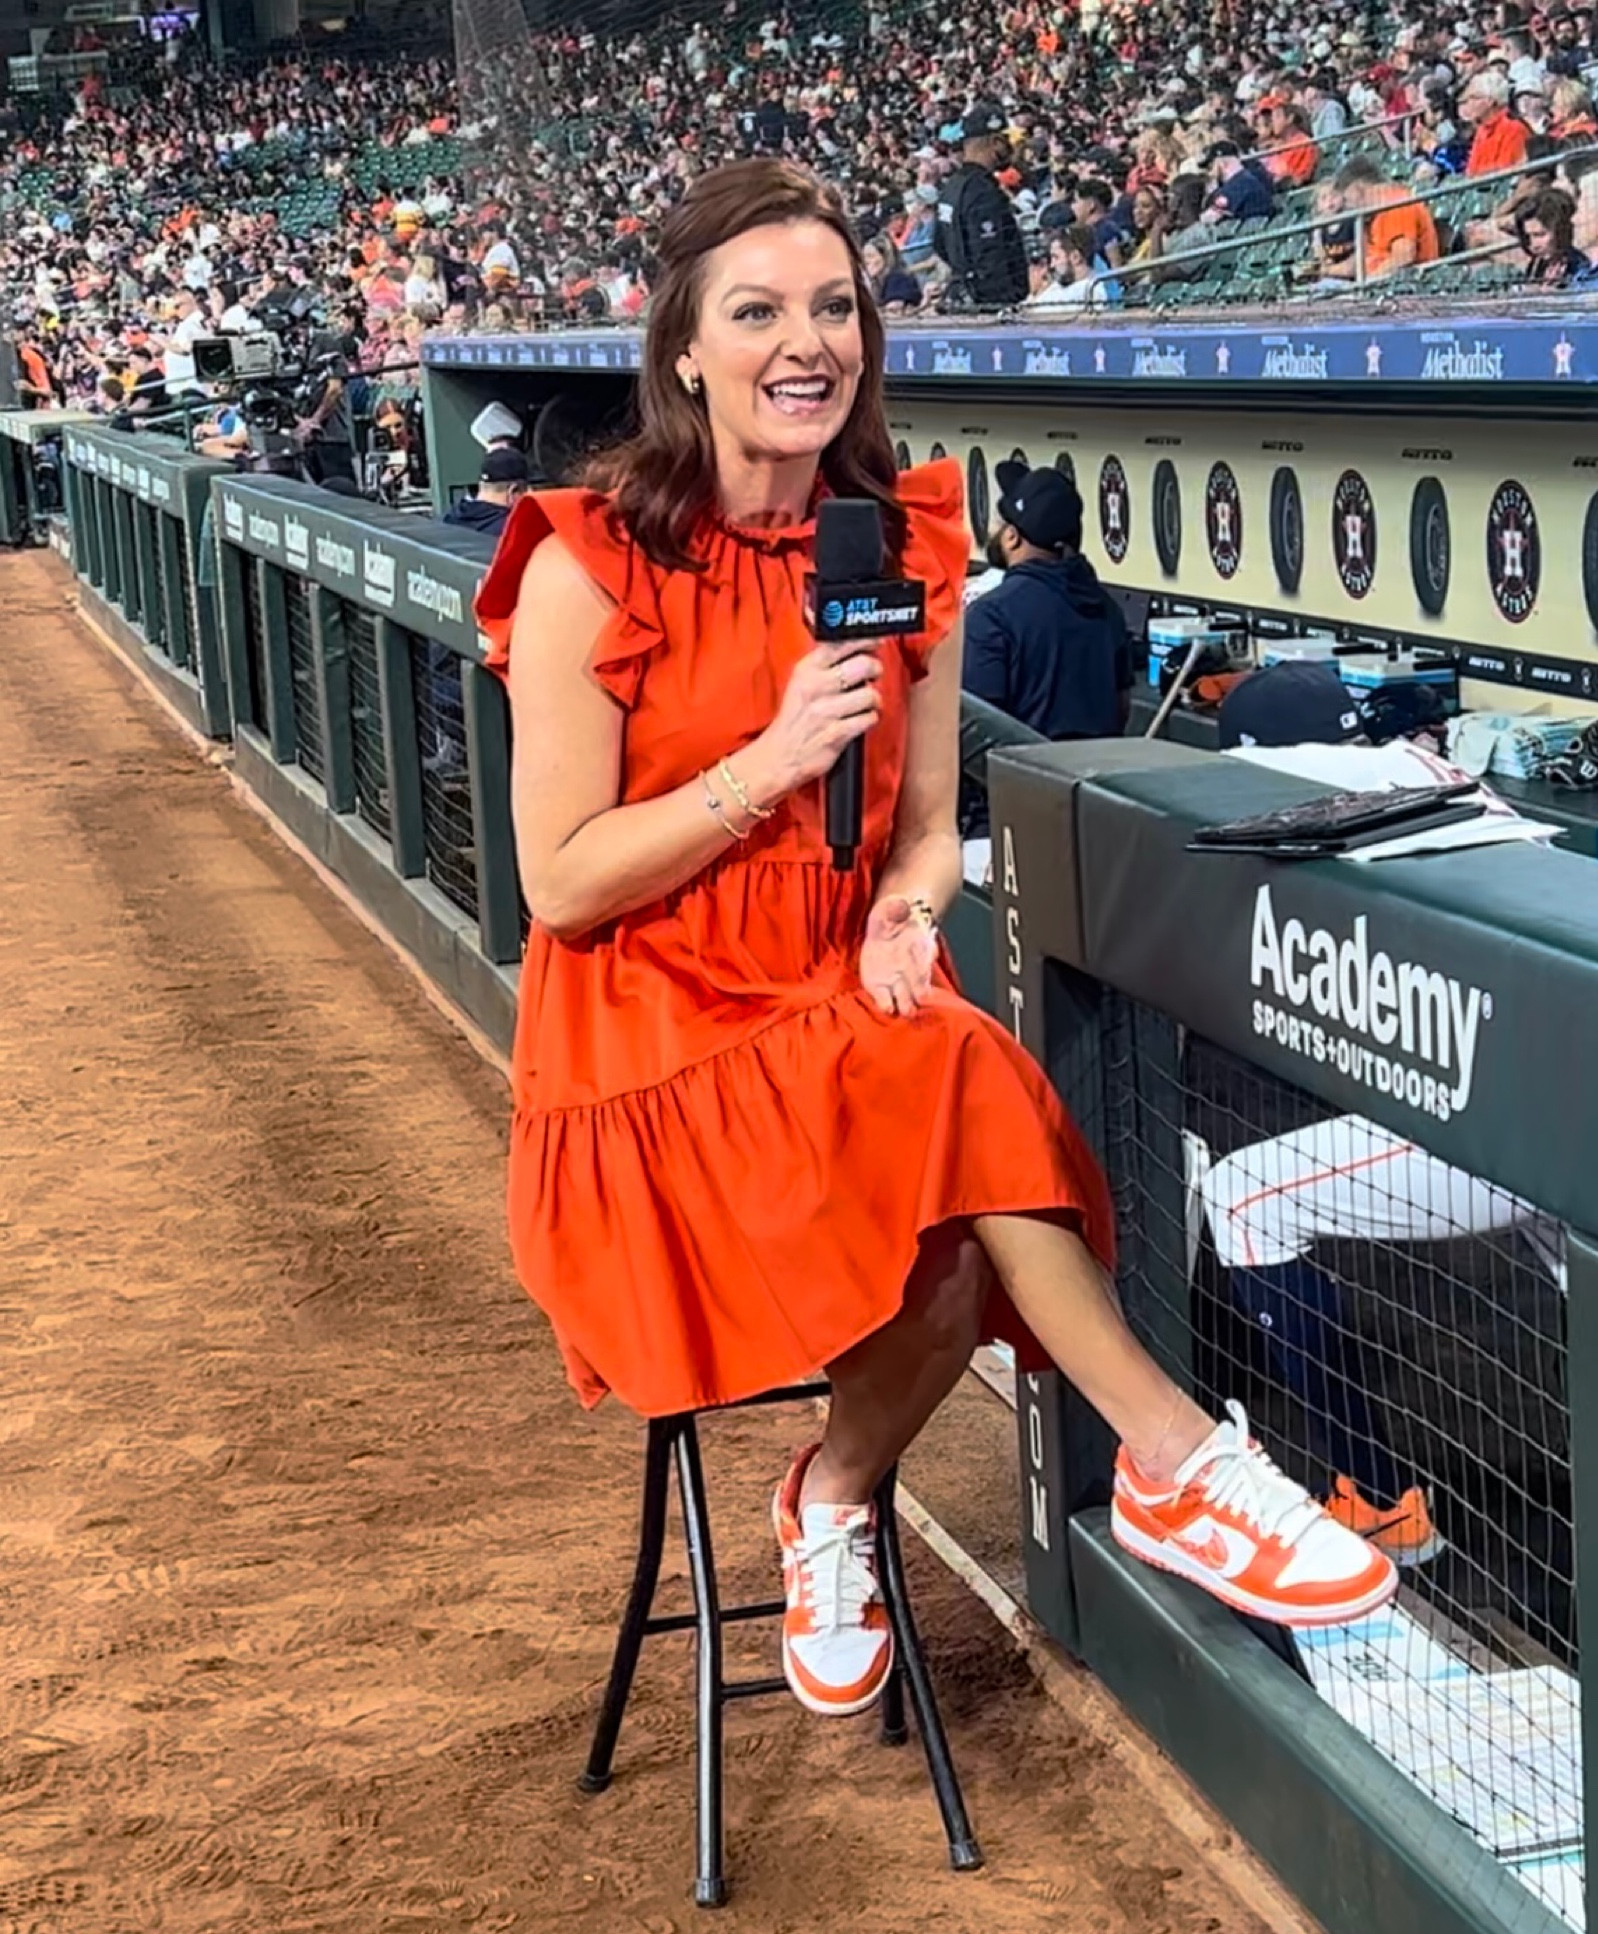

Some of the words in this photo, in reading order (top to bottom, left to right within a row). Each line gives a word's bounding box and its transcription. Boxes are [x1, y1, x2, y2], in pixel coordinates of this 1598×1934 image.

[1421, 341, 1504, 379] Methodist
[1402, 448, 1452, 461] NITTO
[1345, 515, 1363, 557] H
[1503, 530, 1523, 577] H
[845, 606, 918, 626] SPORTSNET
[1251, 883, 1481, 1112] Academy
